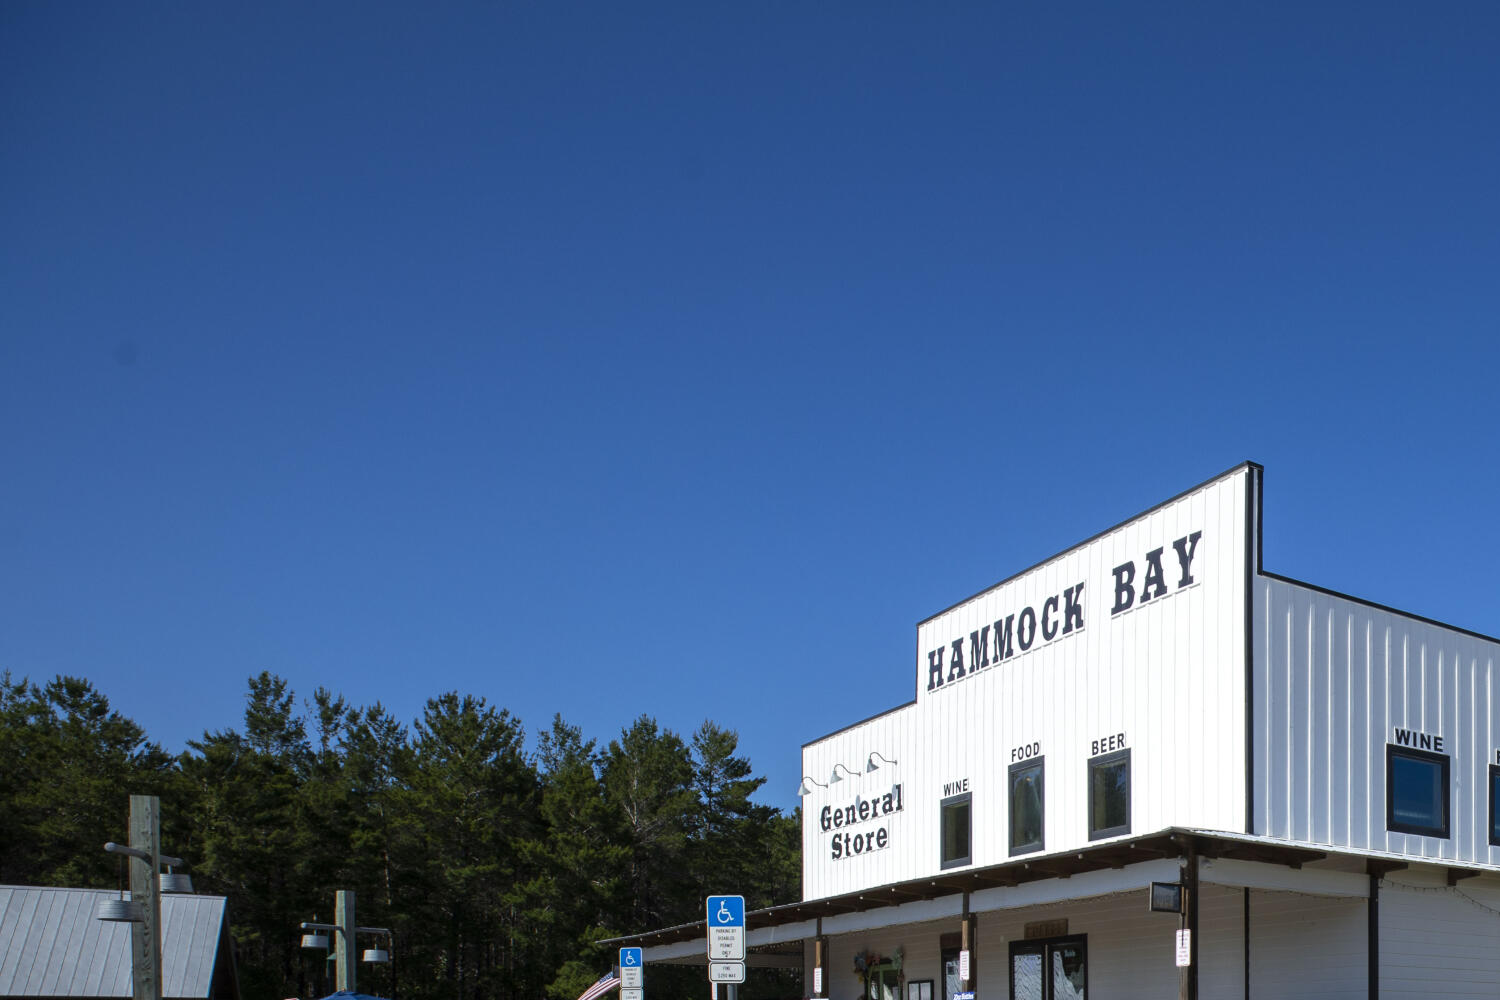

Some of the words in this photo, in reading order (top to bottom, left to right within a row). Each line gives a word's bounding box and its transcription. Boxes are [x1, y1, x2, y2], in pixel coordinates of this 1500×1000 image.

[927, 581, 1085, 691] HAMMOCK
[1111, 530, 1202, 616] BAY
[1011, 741, 1040, 762] FOOD
[1091, 732, 1125, 756] BEER
[1395, 728, 1443, 752] WINE
[943, 778, 969, 797] WINE
[820, 783, 902, 832] General
[831, 827, 888, 860] Store
